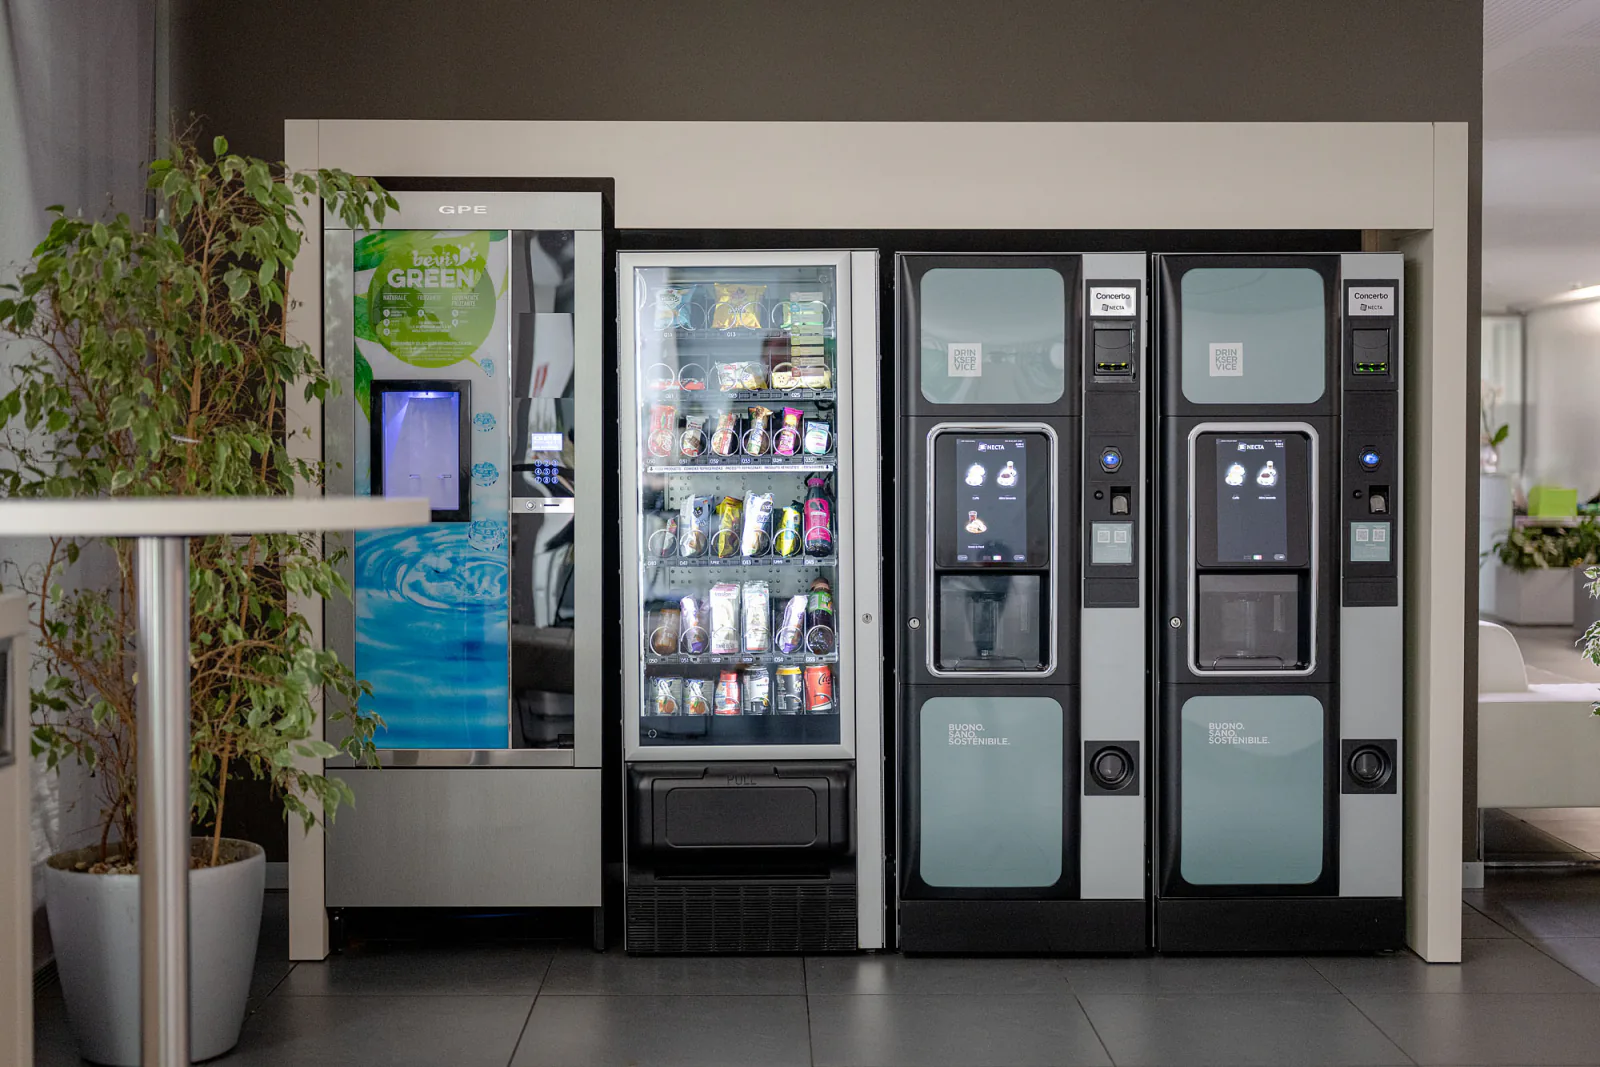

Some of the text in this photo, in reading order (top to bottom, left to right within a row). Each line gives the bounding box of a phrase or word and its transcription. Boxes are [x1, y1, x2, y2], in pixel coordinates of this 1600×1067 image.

[438, 205, 488, 214] GPE
[387, 268, 475, 288] GREEN
[1096, 292, 1130, 300] Concerto
[1354, 292, 1388, 300] Concerto
[954, 349, 976, 357] DRIN
[1215, 348, 1237, 356] DRIN
[954, 356, 976, 364] KSER
[1215, 356, 1237, 364] KSER
[954, 363, 976, 371] VICE
[1215, 363, 1237, 371] VICE
[948, 723, 985, 731] BUONO.
[1208, 722, 1245, 730] BUONO.
[727, 774, 757, 786] PULL
